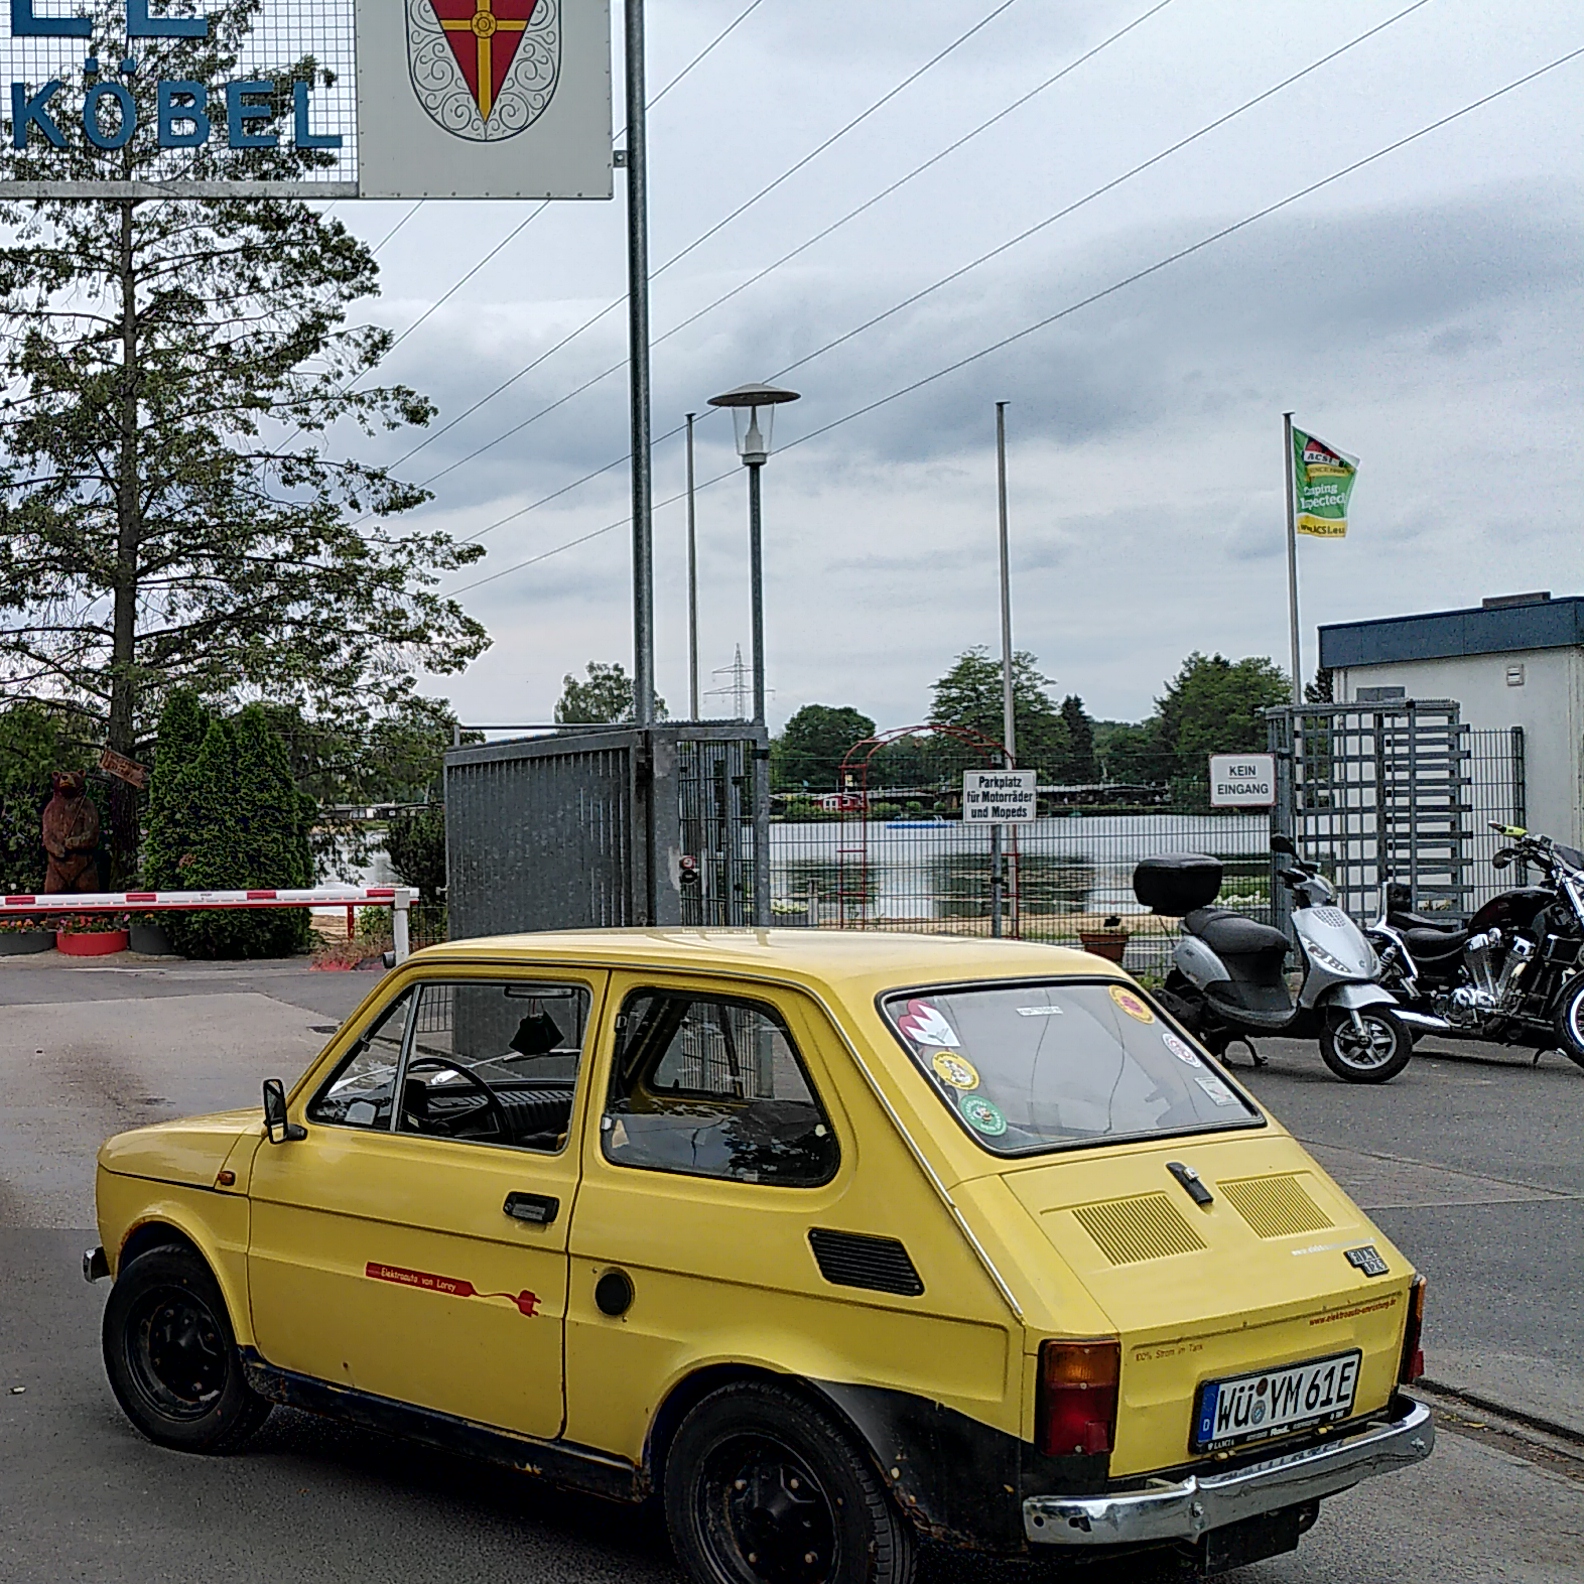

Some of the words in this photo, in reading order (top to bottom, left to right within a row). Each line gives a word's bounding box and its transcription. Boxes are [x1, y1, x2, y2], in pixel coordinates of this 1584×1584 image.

[1307, 452, 1333, 463] ACSI
[1229, 766, 1256, 777] KEIN
[979, 776, 1022, 790] Parkplatz
[1217, 783, 1269, 795] EINGANG
[967, 790, 980, 803] für
[981, 790, 1033, 803] Motorräder
[971, 806, 988, 818] und
[991, 806, 1027, 819] Mopeds
[1347, 1247, 1378, 1264] FIAT
[380, 1268, 418, 1284] Elektroauto
[421, 1276, 434, 1286] von
[1268, 1371, 1304, 1421] YM
[1305, 1360, 1356, 1412] 61E
[1202, 1418, 1211, 1432] D
